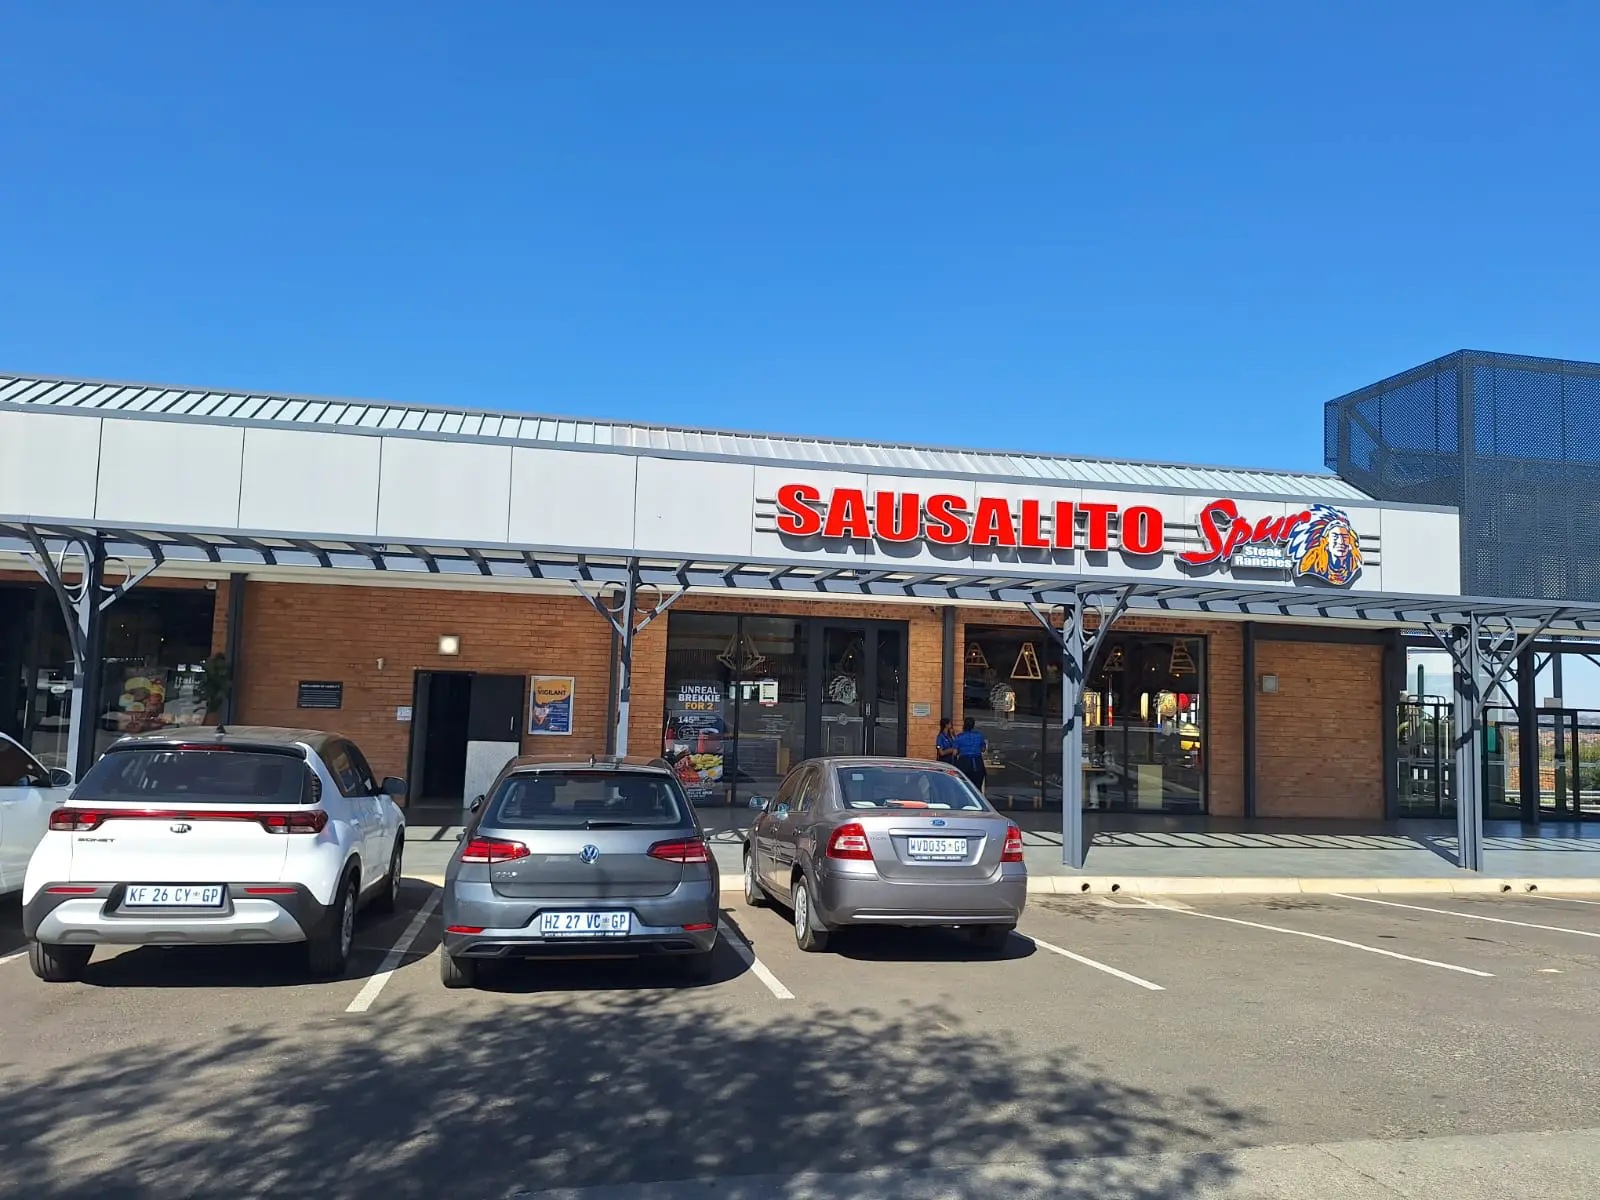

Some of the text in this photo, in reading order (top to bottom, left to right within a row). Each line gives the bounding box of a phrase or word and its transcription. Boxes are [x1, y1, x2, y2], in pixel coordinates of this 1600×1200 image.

[777, 484, 1312, 565] SAUSALITO Spur
[1244, 545, 1283, 558] Steak
[1234, 556, 1293, 568] Ranches
[681, 686, 718, 694] UNREAL
[678, 694, 721, 703] BREKKIE
[685, 702, 714, 710] FOR 2
[954, 840, 966, 852] GP
[129, 887, 218, 903] KF 26 CY GP
[544, 914, 626, 929] HZ 27 VC GP
